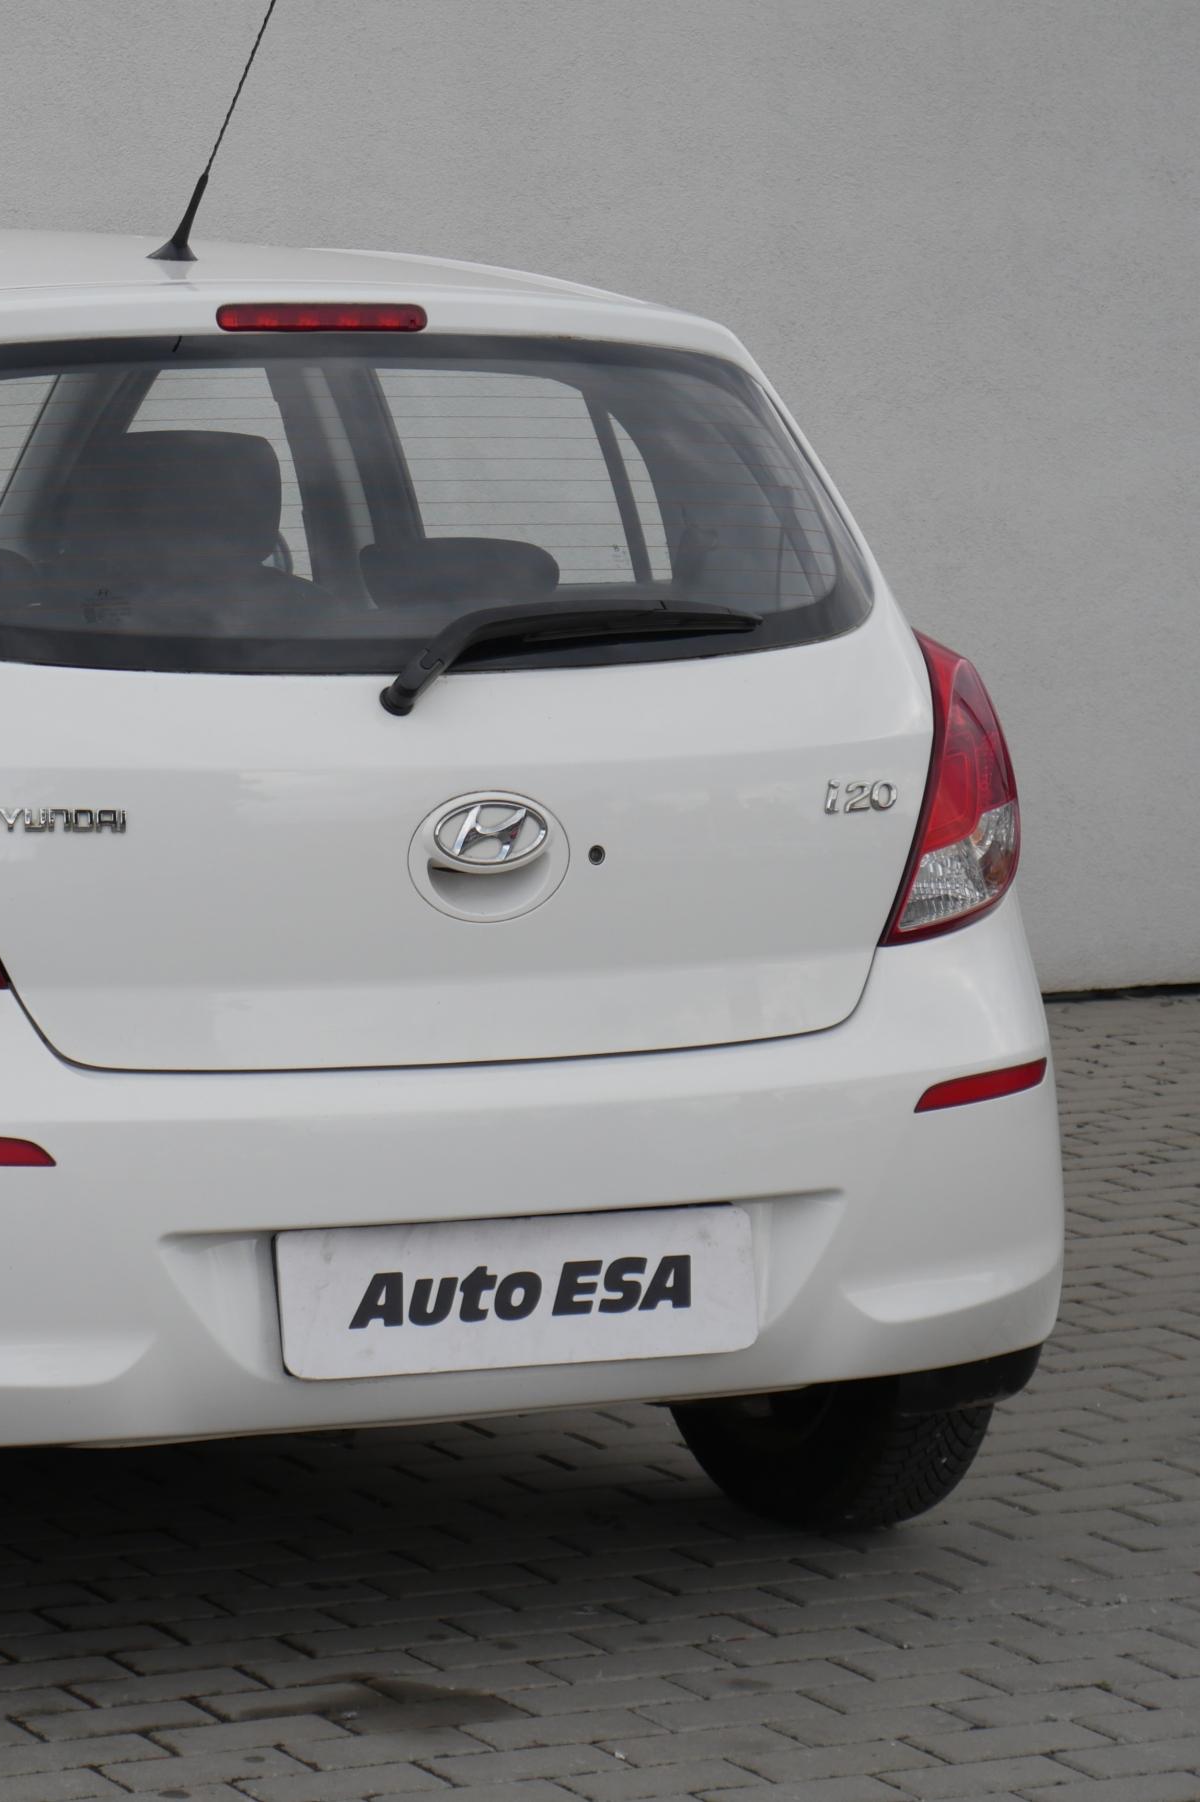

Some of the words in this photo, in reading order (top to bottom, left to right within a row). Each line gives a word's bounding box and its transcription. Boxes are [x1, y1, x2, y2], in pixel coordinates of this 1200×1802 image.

[824, 778, 898, 815] i20
[348, 1265, 542, 1330] Auto
[552, 1254, 692, 1317] ESA
